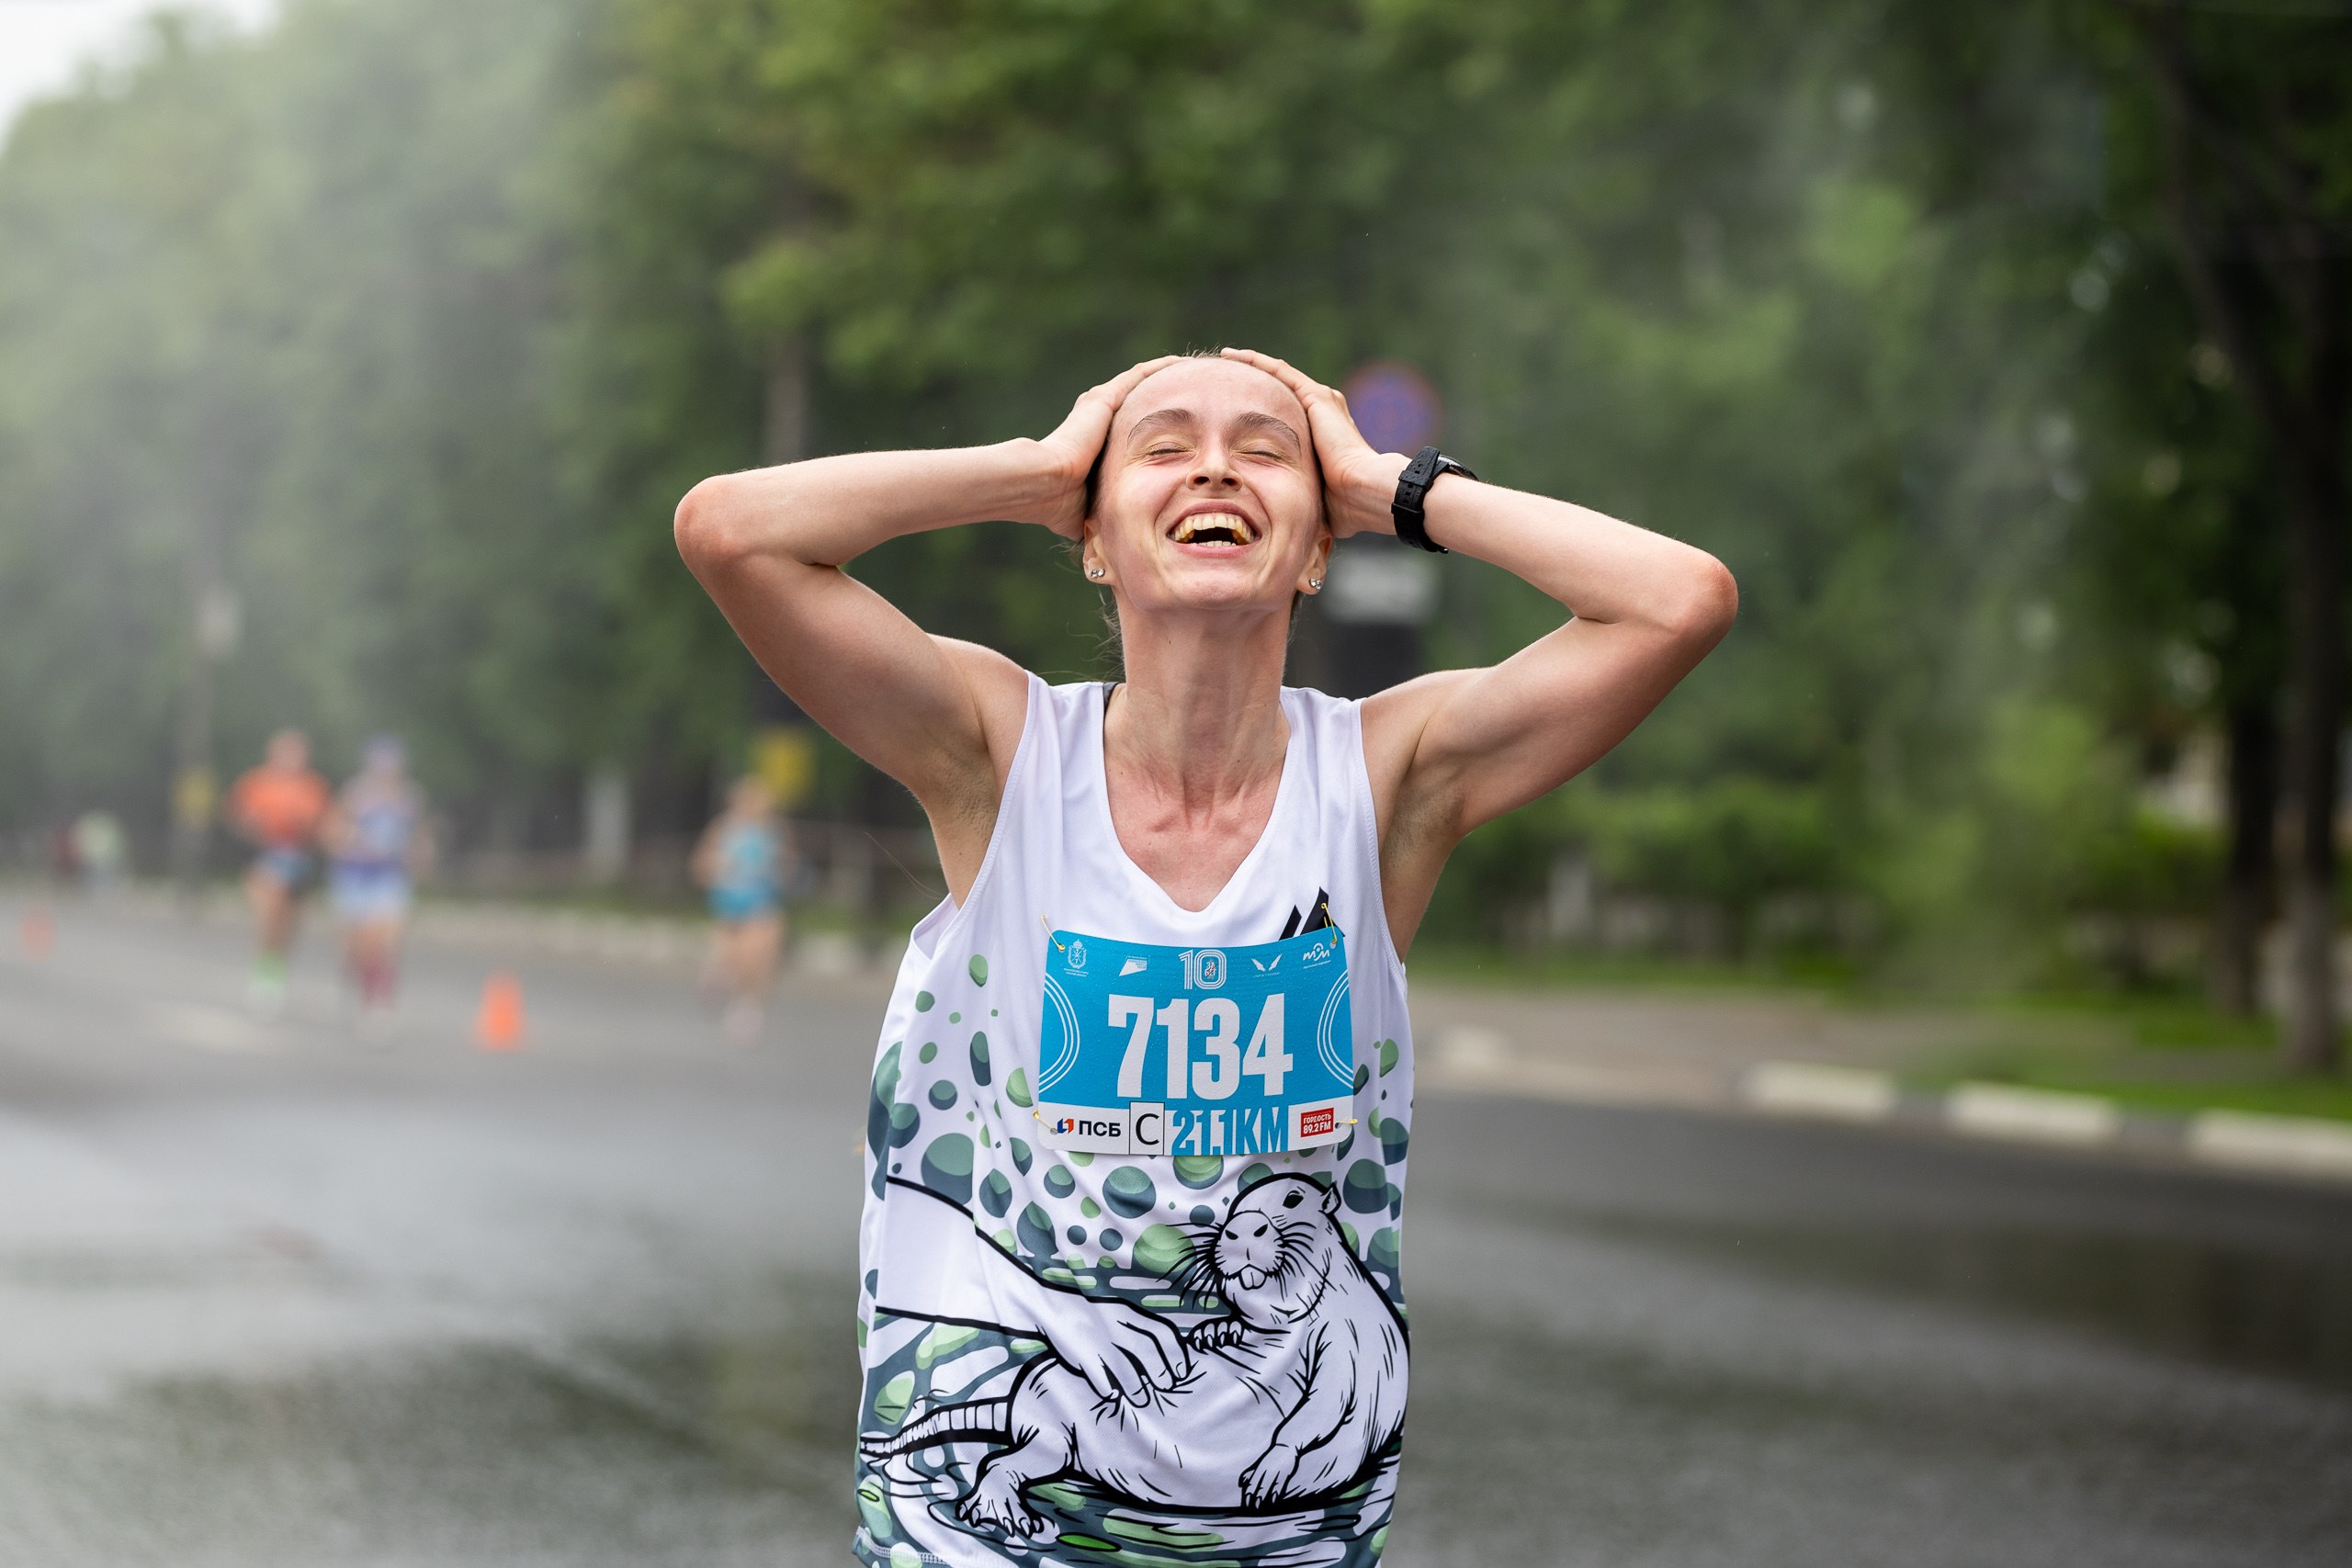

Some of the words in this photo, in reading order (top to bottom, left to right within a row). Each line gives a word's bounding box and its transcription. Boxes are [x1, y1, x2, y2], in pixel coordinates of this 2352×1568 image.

[1178, 949, 1227, 990] 10
[1107, 993, 1294, 1100] 7134
[1079, 1120, 1122, 1138] ПСБ
[1135, 1112, 1160, 1146] C
[1303, 1122, 1318, 1134] 89.2
[1319, 1121, 1331, 1132] FM
